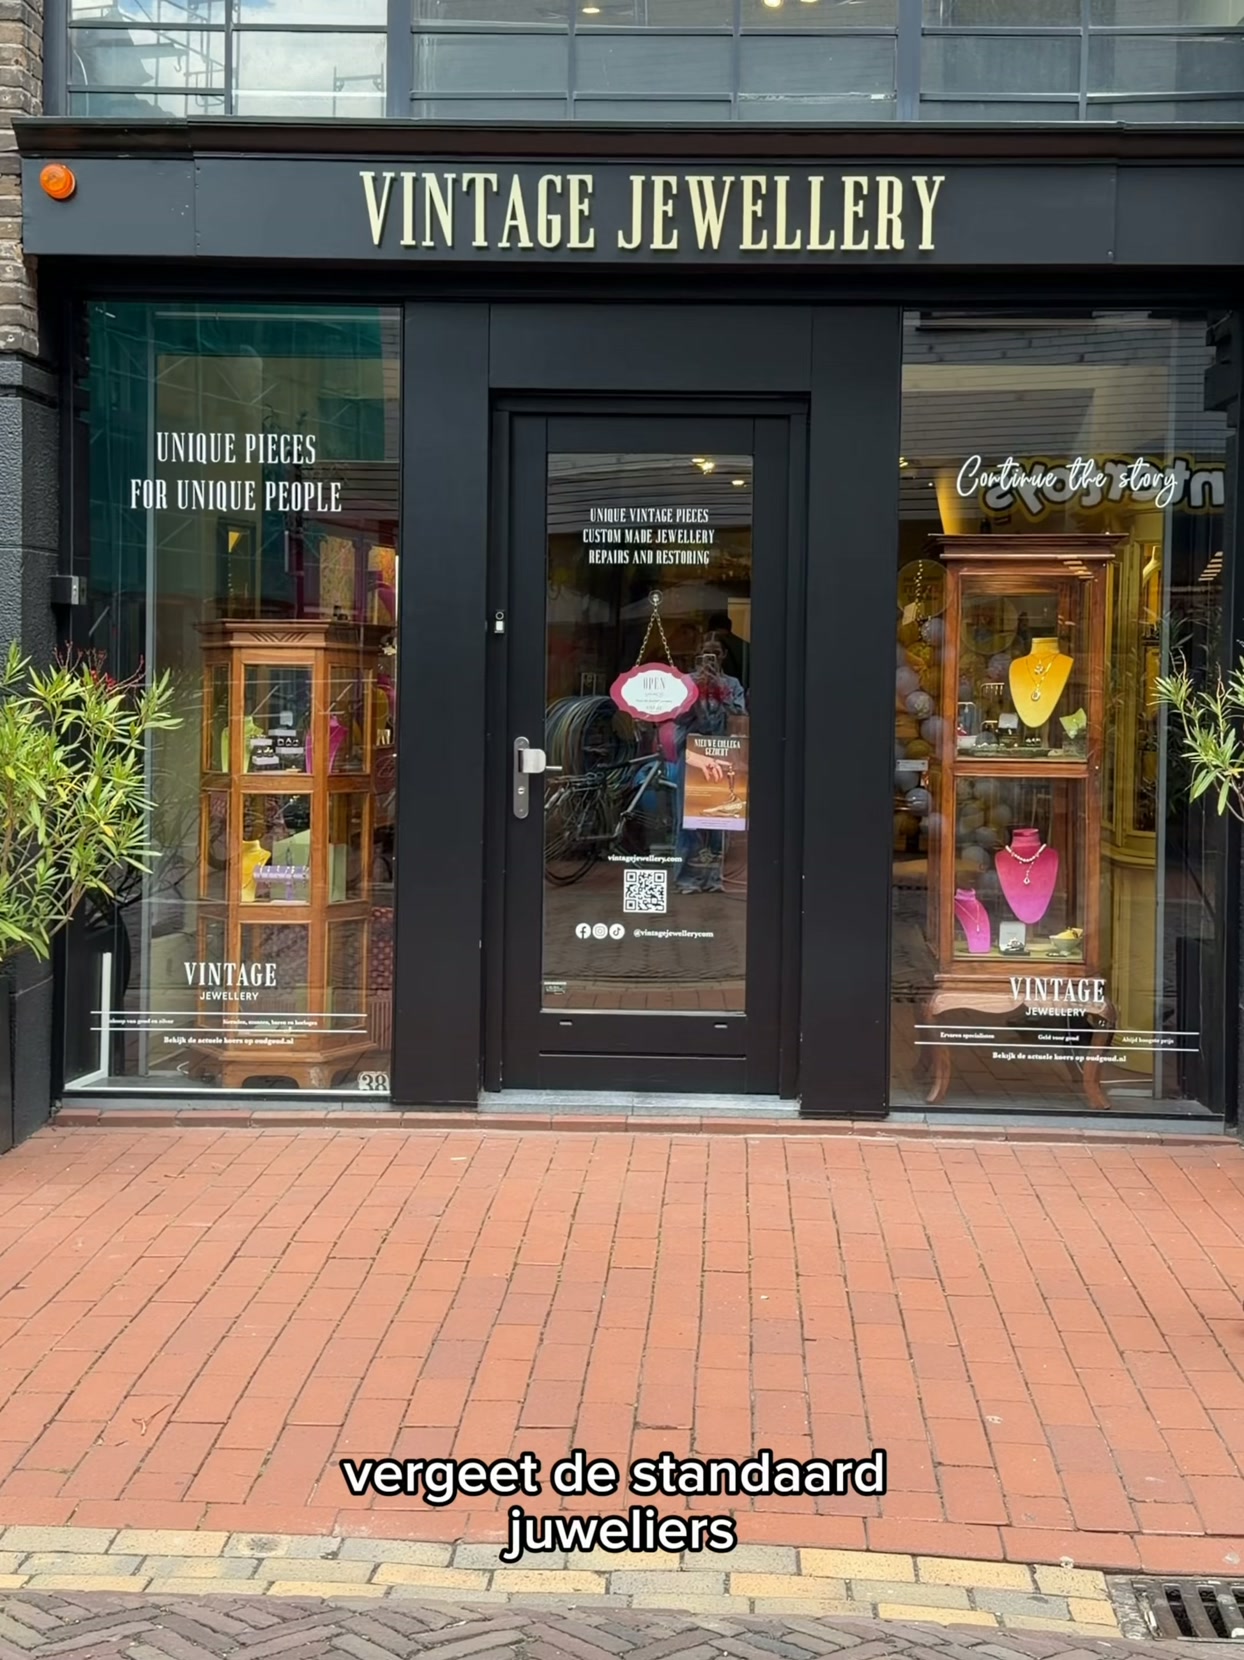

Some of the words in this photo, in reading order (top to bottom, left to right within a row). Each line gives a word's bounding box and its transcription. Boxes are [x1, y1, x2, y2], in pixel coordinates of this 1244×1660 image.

[359, 171, 595, 248] VINTAGE
[617, 175, 945, 250] JEWELLERY
[156, 432, 236, 464] UNIQUE
[245, 433, 316, 464] PIECES
[956, 454, 1057, 497] Continue
[1065, 456, 1108, 491] the
[1118, 456, 1178, 508] story
[130, 479, 168, 509] FOR
[177, 479, 256, 512] UNIQUE
[265, 481, 342, 512] PEOPLE
[590, 508, 626, 523] UNIQUE
[629, 508, 673, 523] VINTAGE
[676, 508, 709, 523] PIECES
[583, 528, 621, 543] CUSTOM
[624, 529, 653, 543] MADE
[655, 529, 715, 544] JEWELLERY
[588, 549, 629, 564] REPAIRS
[632, 550, 653, 564] AND
[656, 550, 710, 565] RESTORING
[642, 676, 666, 690] OPEN
[607, 853, 683, 864] vintagejewellery.com
[633, 928, 714, 939] @vintagejewellerycom
[184, 961, 277, 988] VINTAGE
[200, 991, 260, 1001] JEWELLERY
[1009, 976, 1106, 1003] VINTAGE
[1025, 1006, 1087, 1017] JEWELLERY
[164, 1036, 186, 1045] Bekijk
[254, 1037, 294, 1046] oudgoud.nl
[992, 1052, 1015, 1060] Bekijk
[1054, 1053, 1074, 1061] koers
[1086, 1054, 1127, 1063] oudgoud.nl
[361, 1073, 388, 1091] 38
